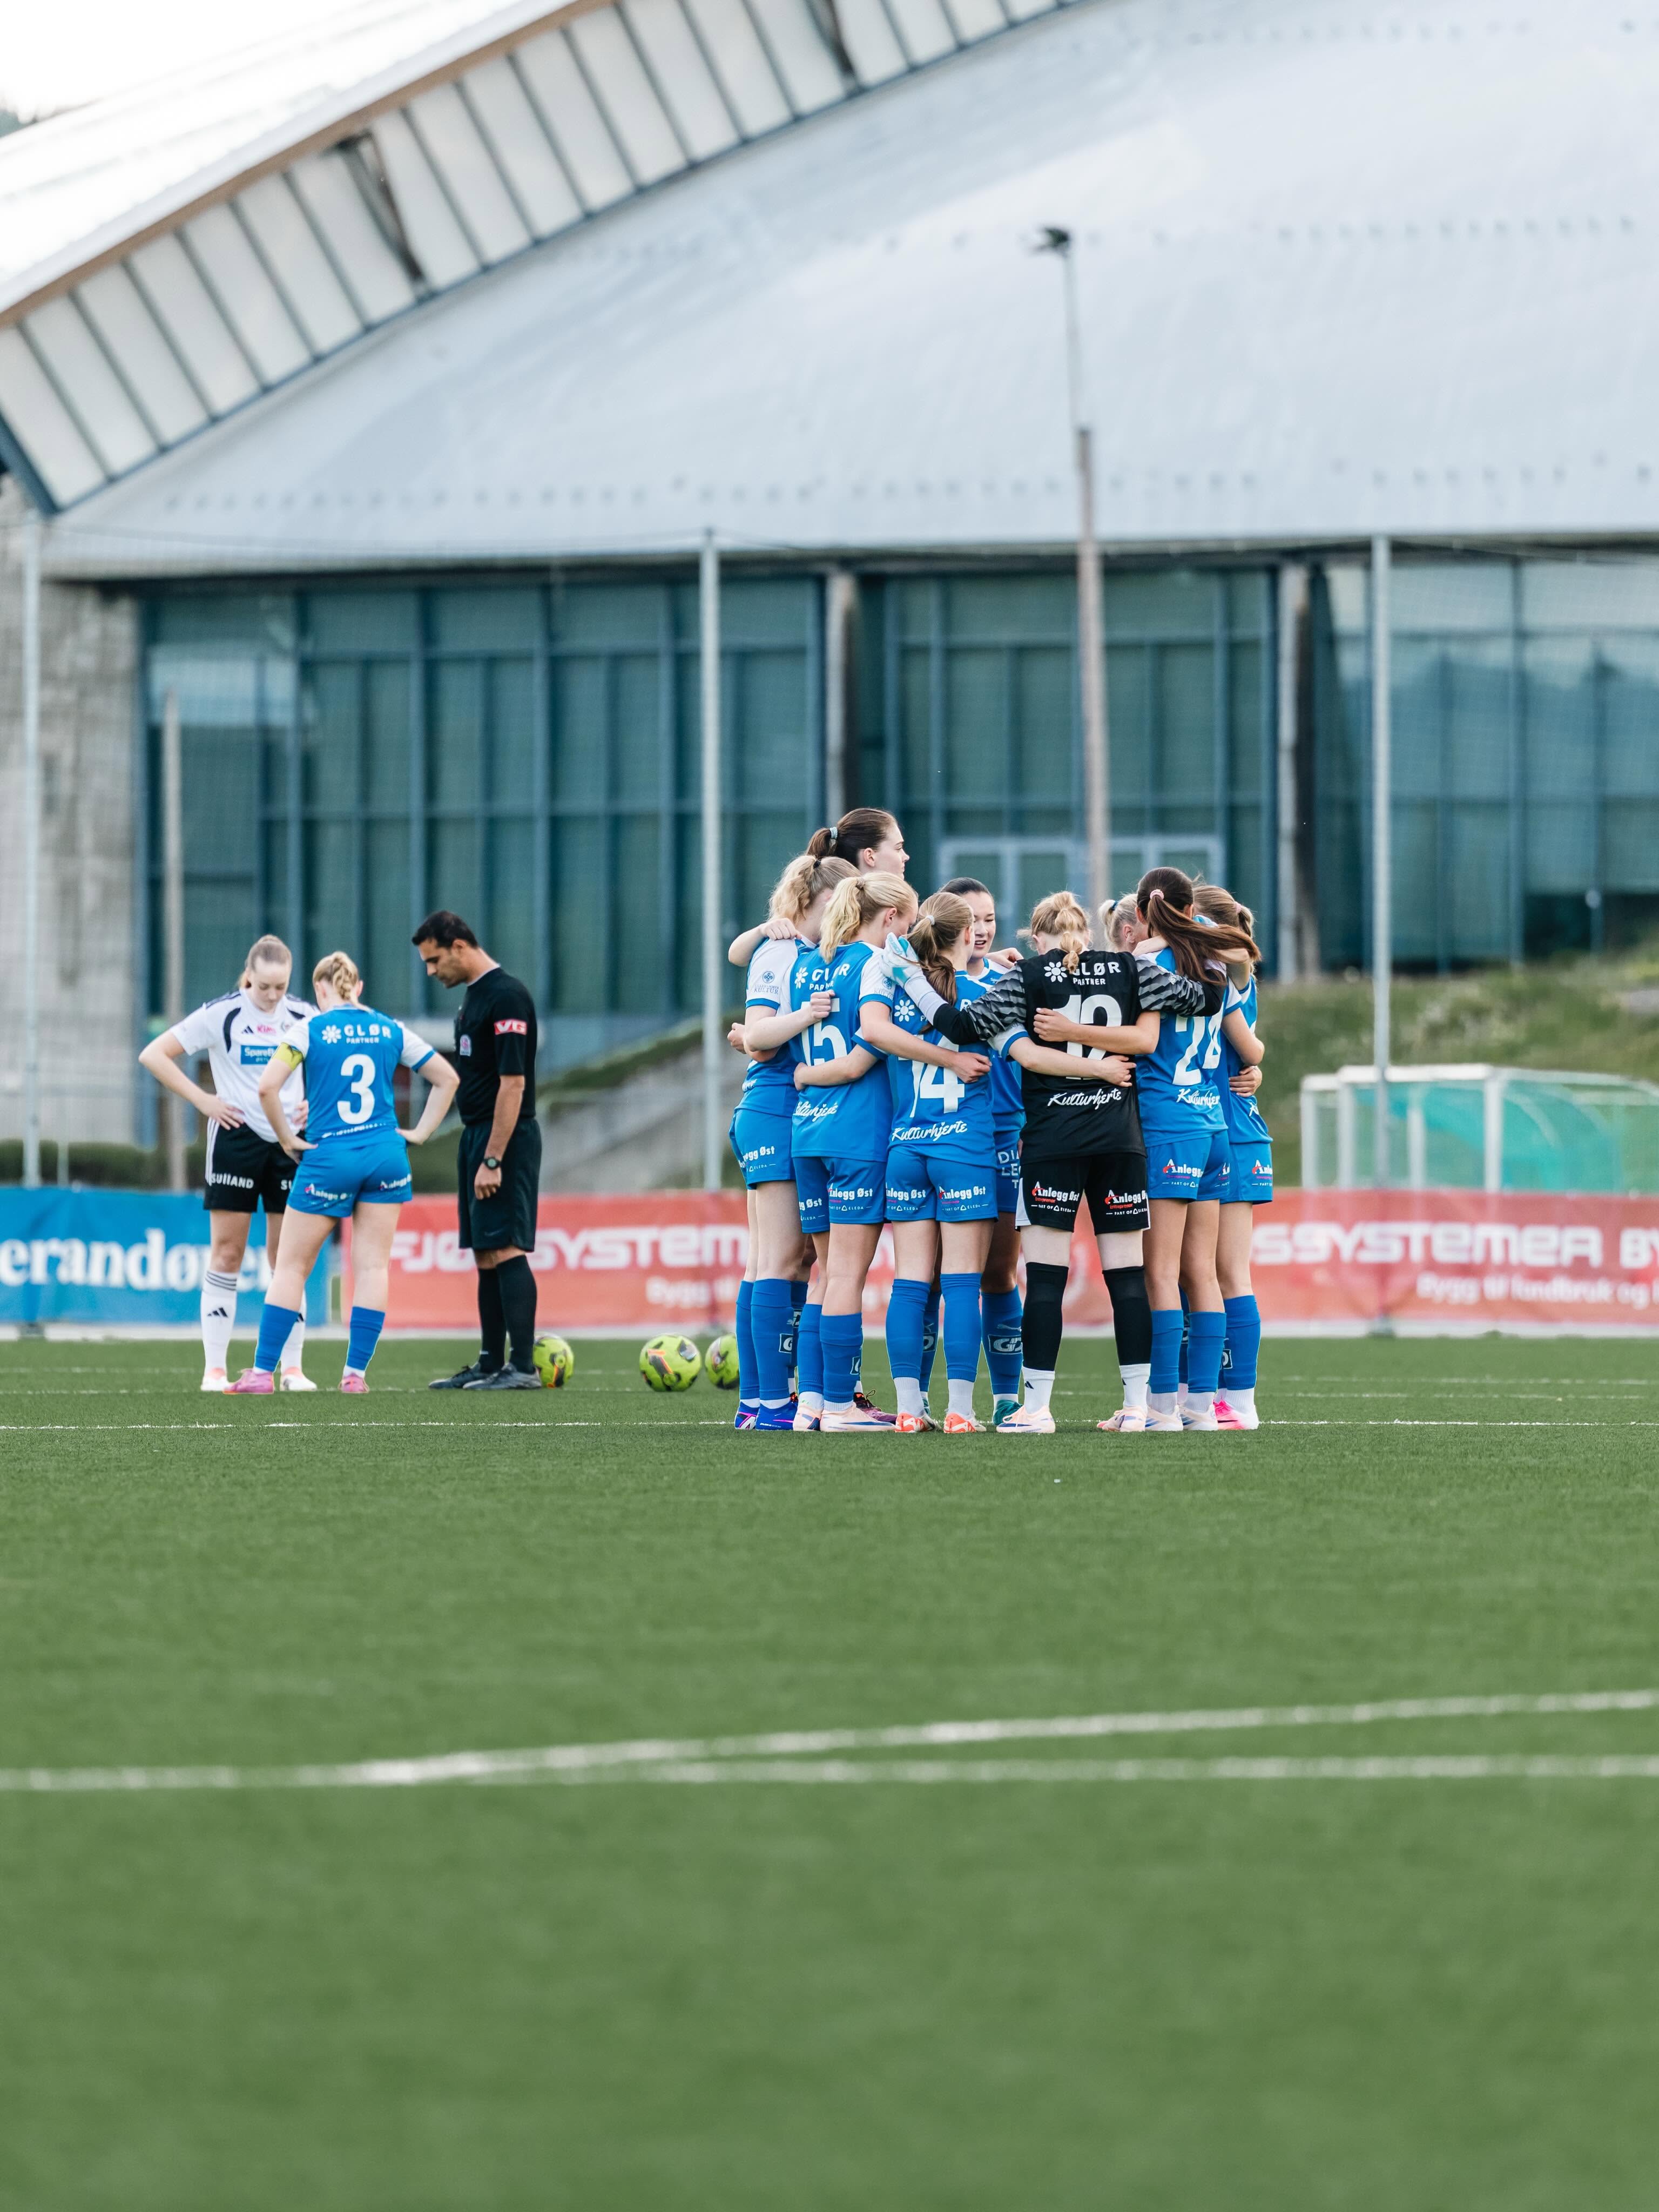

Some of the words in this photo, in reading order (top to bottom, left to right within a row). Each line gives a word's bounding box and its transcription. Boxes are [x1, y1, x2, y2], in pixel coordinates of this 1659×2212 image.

[1073, 977, 1105, 986] PARTNER
[343, 1024, 392, 1038] GLØR
[497, 1019, 527, 1034] VG
[1053, 994, 1122, 1080] 12
[898, 1034, 965, 1118] 14
[337, 1054, 376, 1124] 3
[1047, 1087, 1122, 1110] Kulturhjerte
[892, 1120, 968, 1142] Kulturhjerte
[759, 1146, 775, 1156] Øst
[857, 1188, 873, 1197] Øst
[911, 1189, 926, 1199] Øst
[939, 1186, 972, 1200] Anlegg
[973, 1186, 986, 1196] Øst
[1031, 1181, 1068, 1202] Anlegg
[1103, 1189, 1141, 1205] Anlegg
[806, 1198, 822, 1209] Øst
